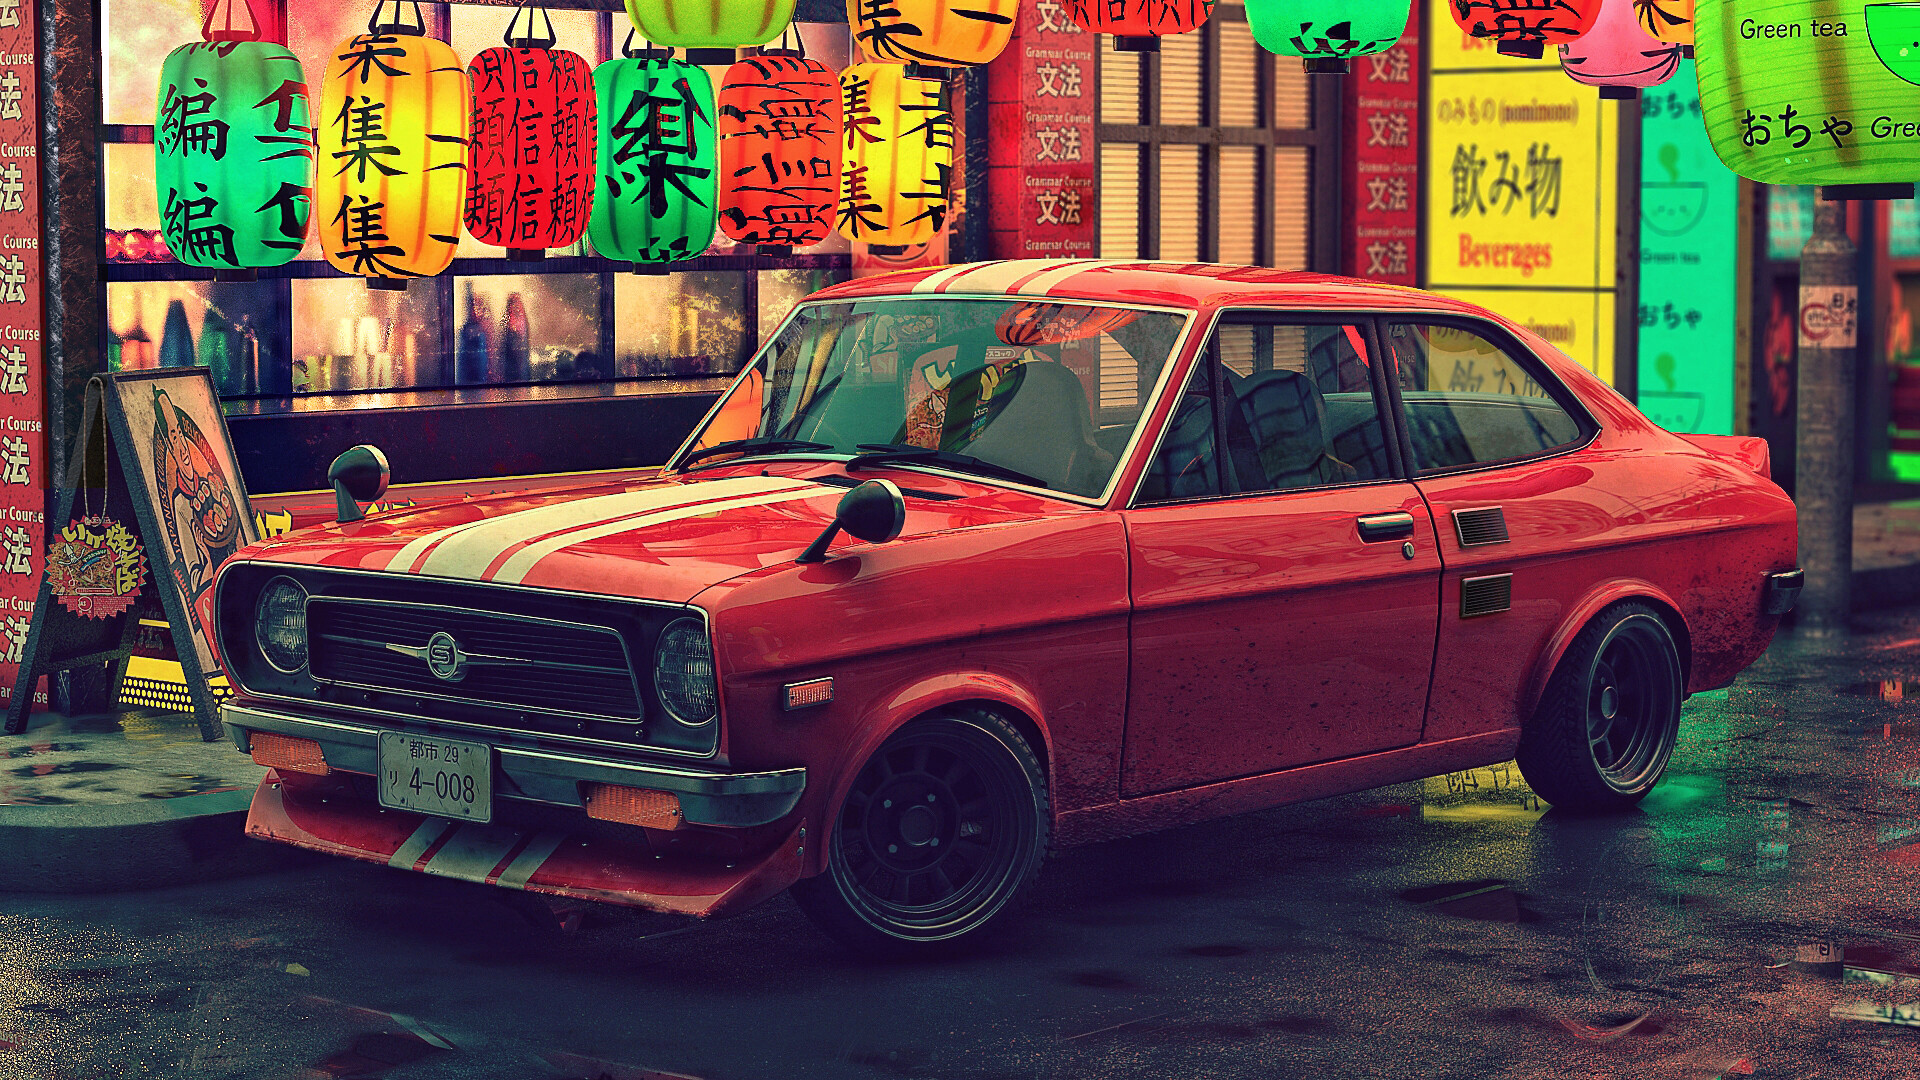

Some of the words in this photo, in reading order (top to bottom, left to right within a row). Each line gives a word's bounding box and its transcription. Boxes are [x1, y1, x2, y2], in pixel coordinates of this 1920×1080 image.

[1740, 18, 1801, 39] Green
[1811, 20, 1848, 37] tea
[0, 50, 34, 66] Course
[1026, 46, 1063, 59] Grammar
[1065, 46, 1092, 60] Course
[1036, 62, 1083, 98] 文法
[1036, 126, 1082, 162] 文法
[1367, 111, 1409, 147] 文法
[1741, 104, 1853, 148] おちゃ
[1, 142, 37, 158] Course
[1367, 176, 1409, 212] 文法
[1450, 142, 1563, 219] 飲み物
[1036, 190, 1082, 226] 文法
[3, 233, 38, 250] Course
[1366, 240, 1408, 276] 文法
[1459, 232, 1553, 278] Beverages
[5, 324, 40, 341] Course
[0, 344, 29, 396] 法
[7, 415, 42, 432] Course
[0, 436, 30, 486] 法
[9, 505, 44, 523] Course
[2, 526, 33, 577] 法
[410, 739, 438, 761] 都市
[444, 745, 458, 763] 29
[409, 767, 475, 804] 4-008
